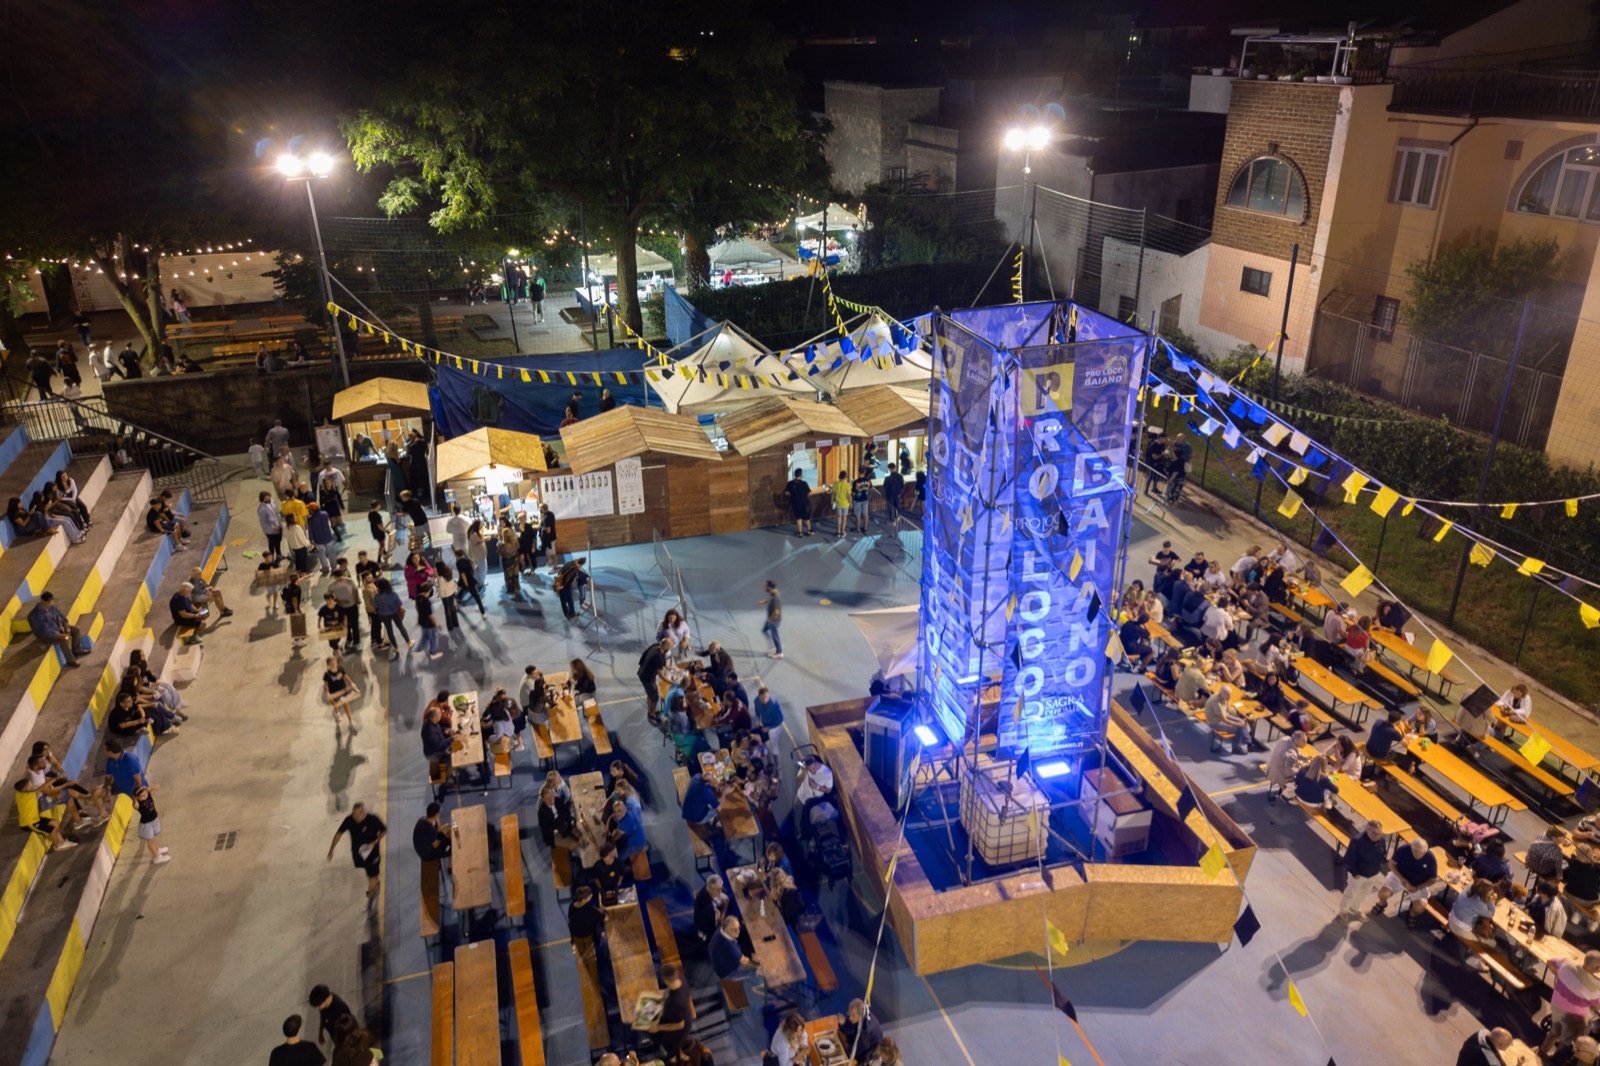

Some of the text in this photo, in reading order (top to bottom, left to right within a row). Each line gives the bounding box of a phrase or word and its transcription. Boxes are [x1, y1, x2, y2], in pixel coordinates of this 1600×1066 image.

[1084, 375, 1123, 387] BAIANO
[1085, 366, 1124, 378] PRO LOCO
[1028, 371, 1061, 500] PRO
[1065, 457, 1112, 687] BAIANO
[1013, 551, 1051, 697] LOCO
[1045, 693, 1085, 710] SAGRA
